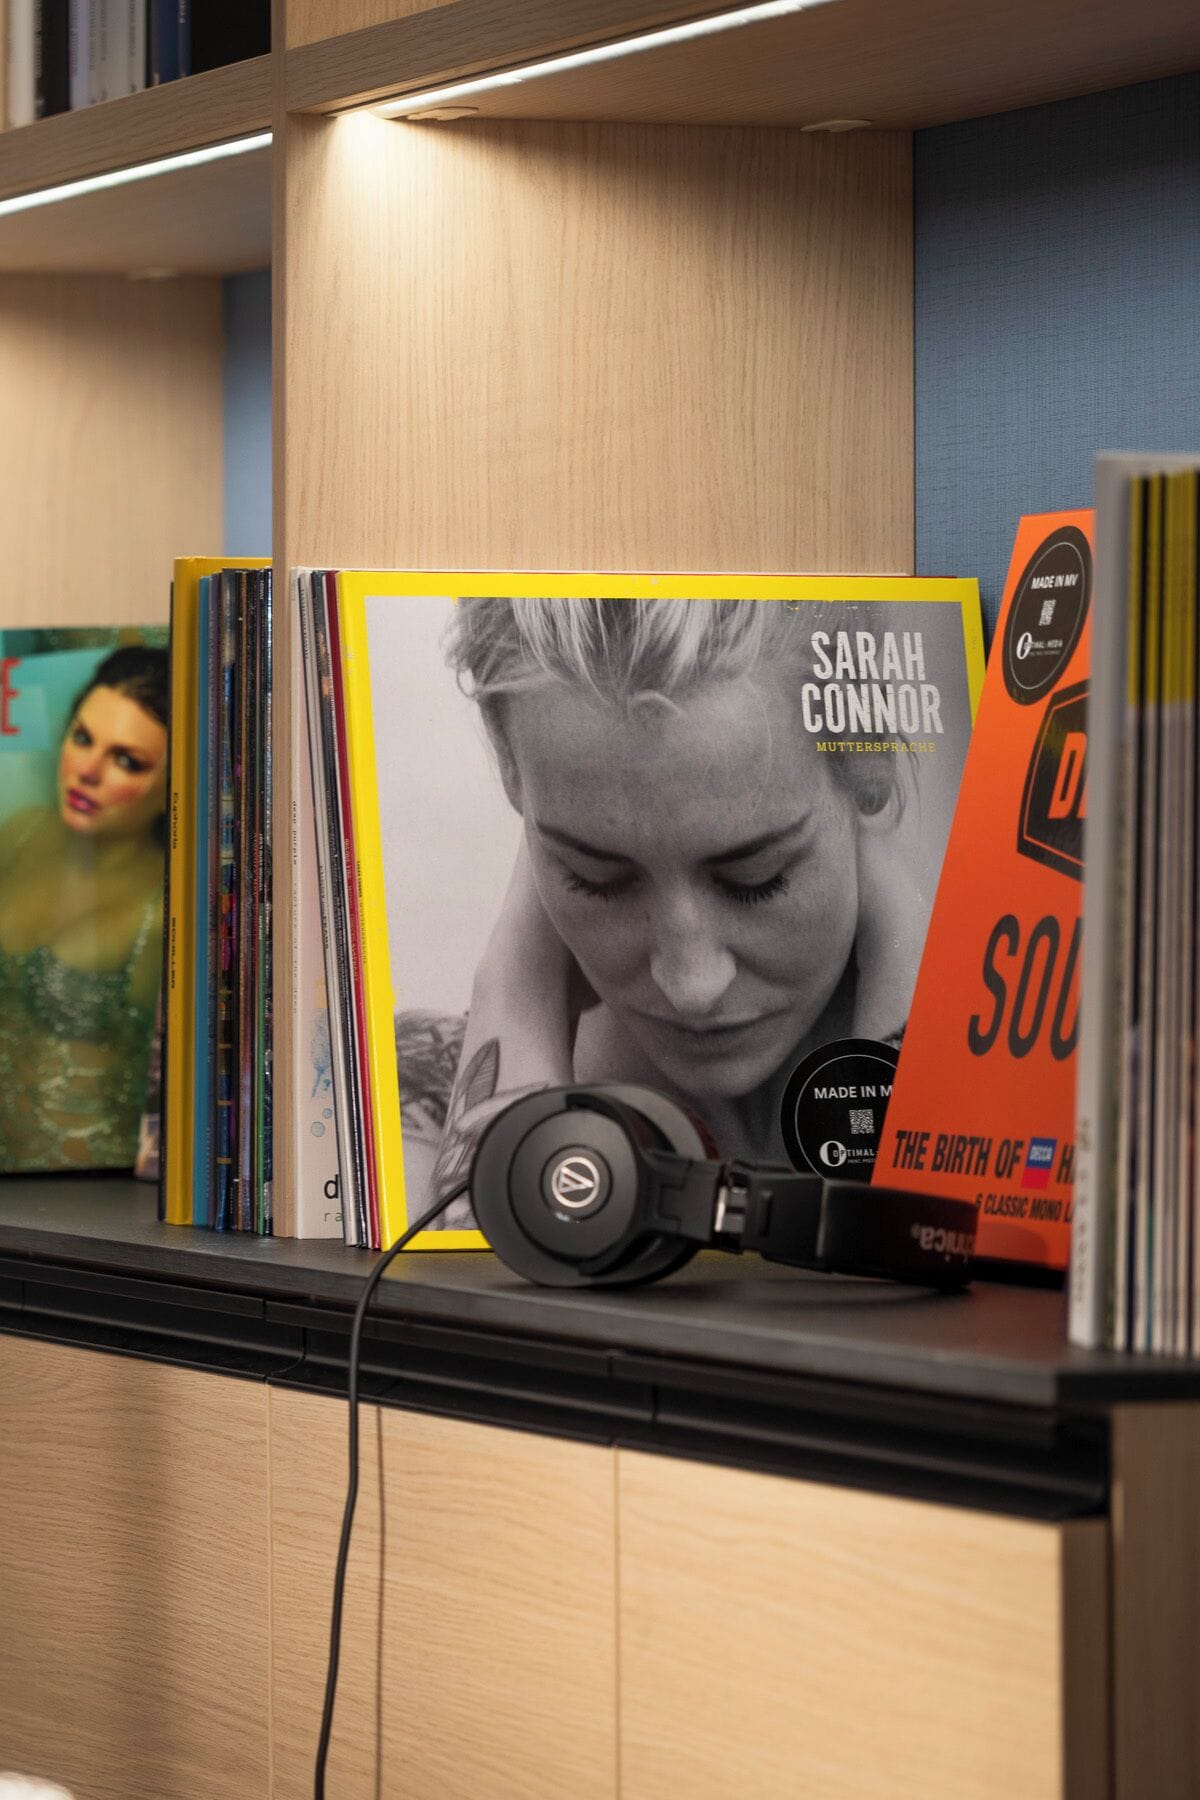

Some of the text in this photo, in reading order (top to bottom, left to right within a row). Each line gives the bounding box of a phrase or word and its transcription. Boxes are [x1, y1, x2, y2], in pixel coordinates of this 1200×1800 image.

[1031, 573, 1079, 589] MADE IN MV
[810, 631, 926, 680] SARAH
[801, 683, 944, 733] CONNOR
[816, 741, 937, 753] MUTTERSPRACHE
[1047, 732, 1088, 820] D
[814, 1086, 858, 1099] MADE
[861, 1085, 876, 1097] IN
[892, 1130, 931, 1170] THE
[931, 1134, 992, 1177] BIRTH
[994, 1138, 1024, 1180] OF
[984, 1194, 1027, 1217] CLASSIC
[1029, 1198, 1062, 1222] MONO
